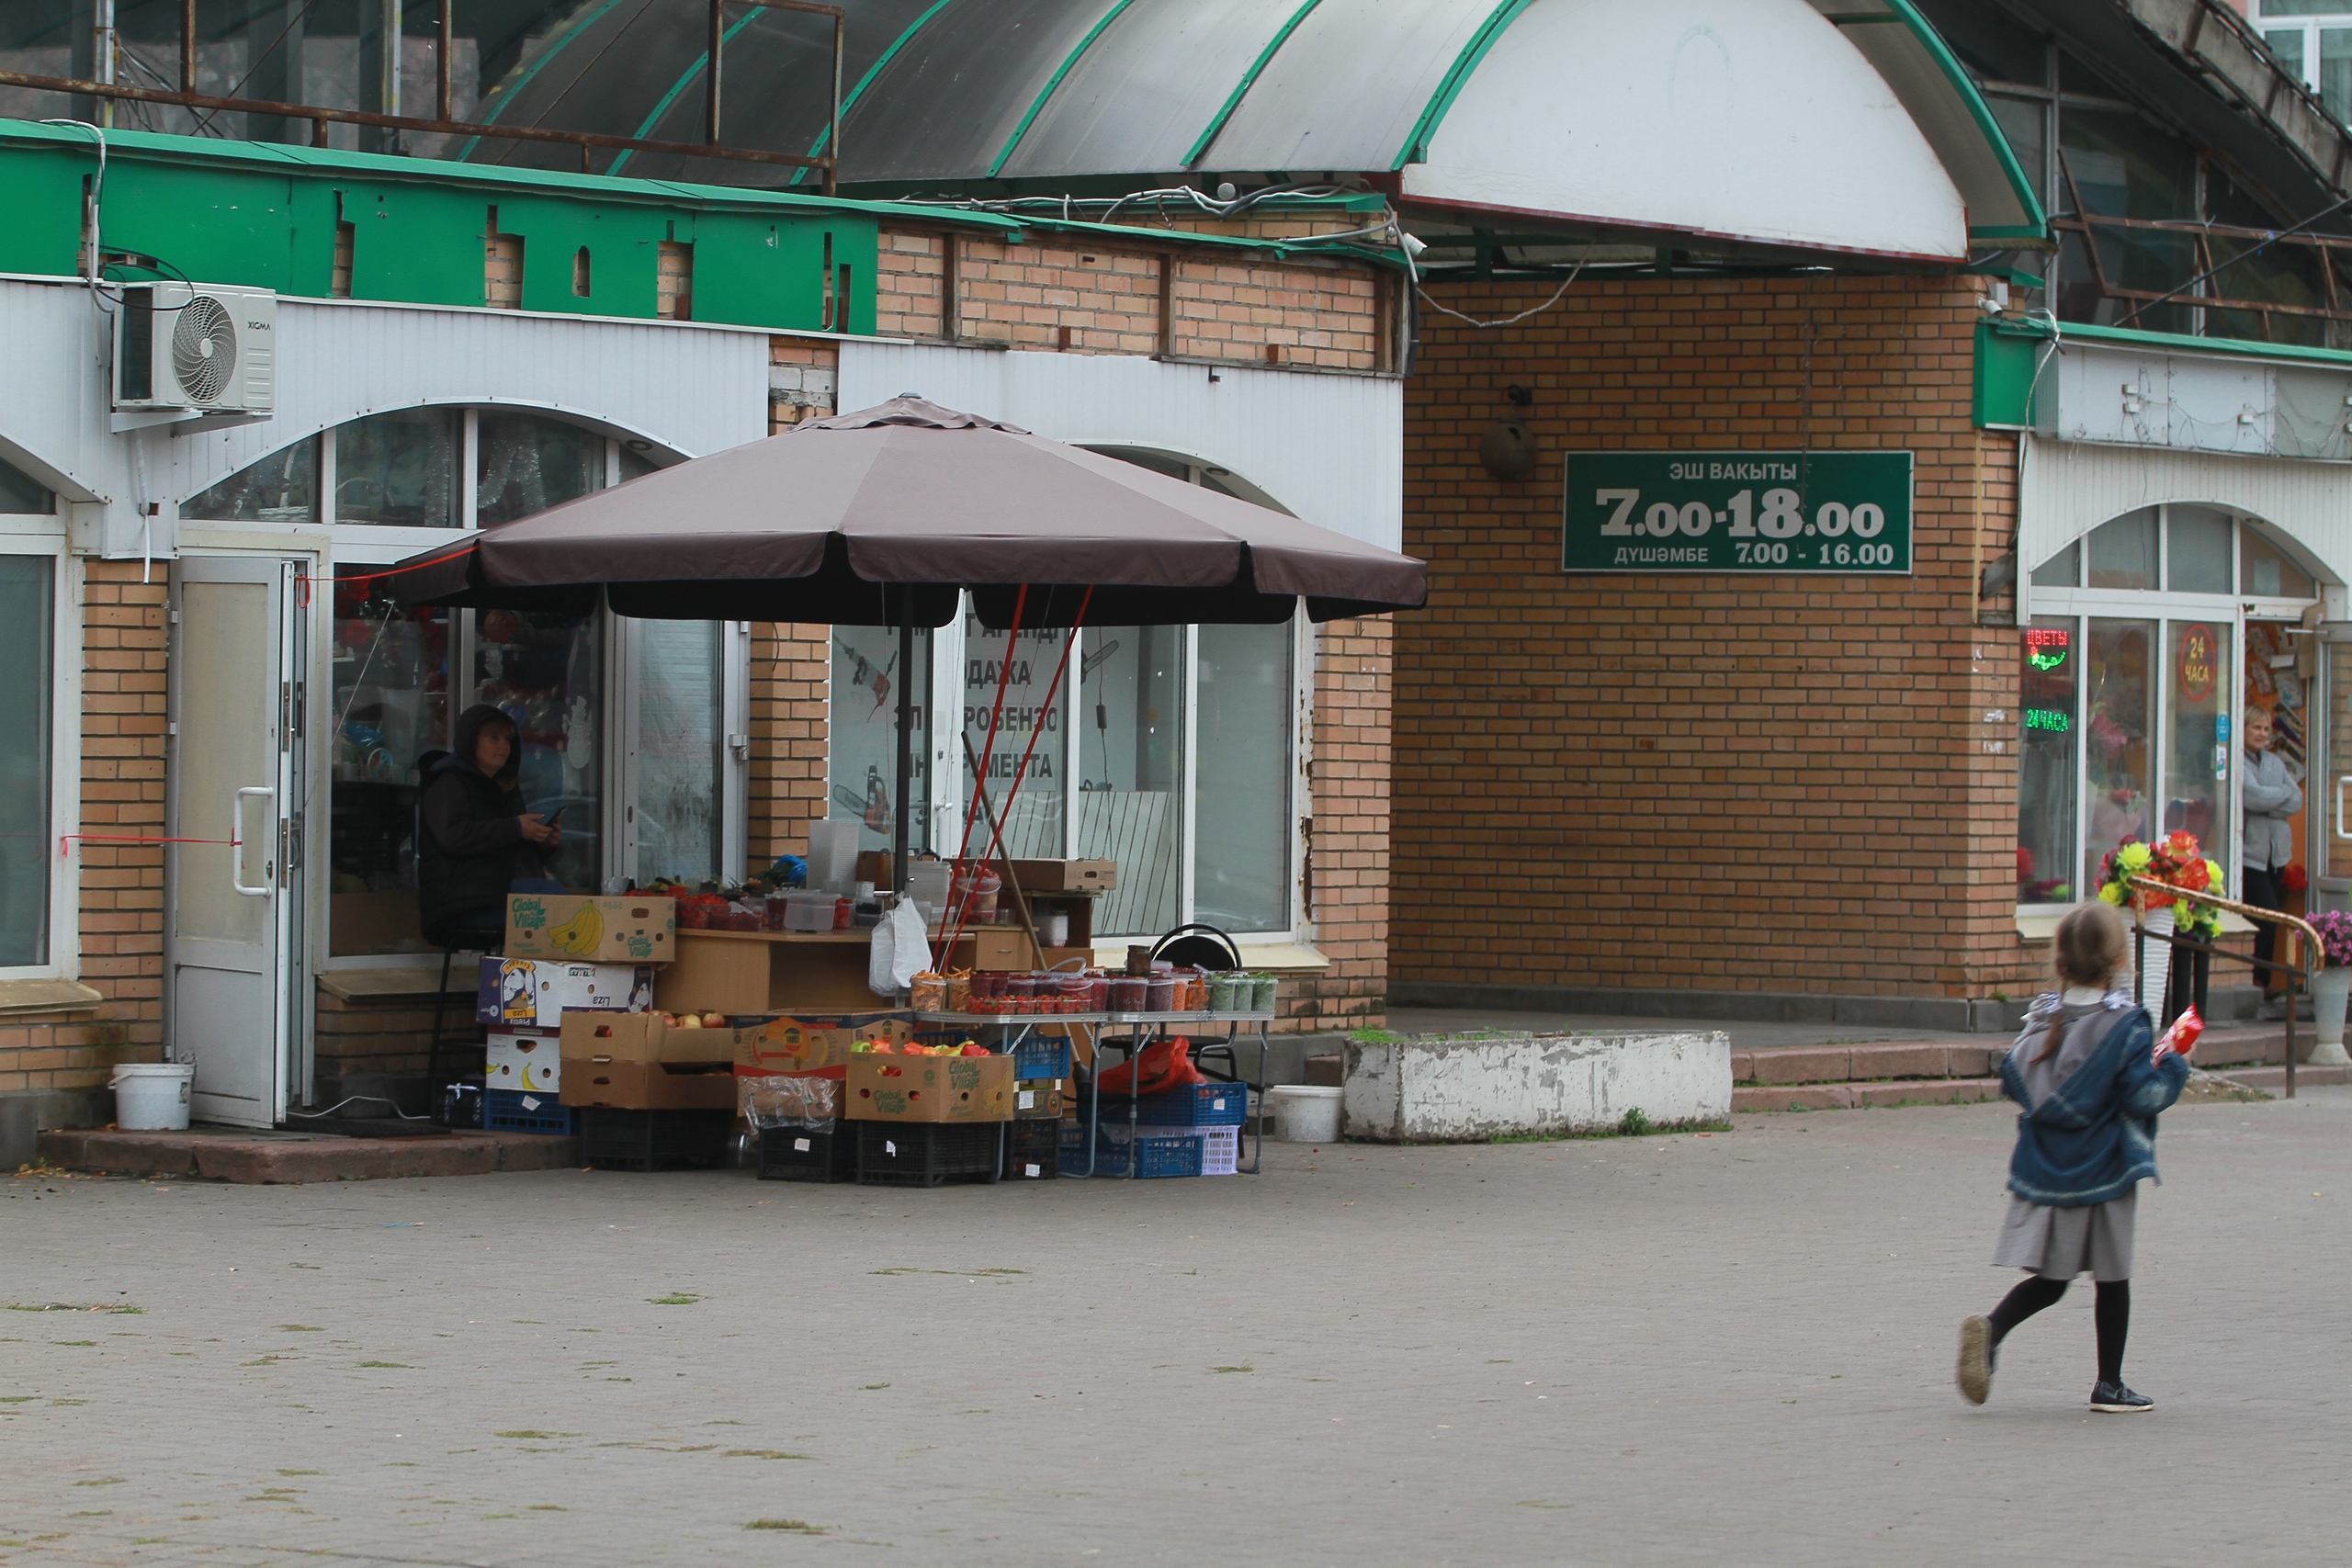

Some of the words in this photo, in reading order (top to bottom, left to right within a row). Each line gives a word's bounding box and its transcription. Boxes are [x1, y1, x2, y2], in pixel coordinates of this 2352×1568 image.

[247, 321, 271, 331] XIGMA
[1669, 463, 1704, 480] ЭШ
[1709, 463, 1797, 479] ВАКЫТЫ
[1735, 542, 1789, 564] 7.00
[1819, 543, 1894, 565] 16.00
[2190, 636, 2204, 659] 24
[2185, 664, 2209, 682] ЧАСА
[512, 897, 543, 913] Global
[513, 912, 547, 931] Village
[628, 935, 650, 947] Global
[593, 996, 611, 1007] Liza
[948, 1058, 978, 1076] Global
[873, 1089, 902, 1102] Global
